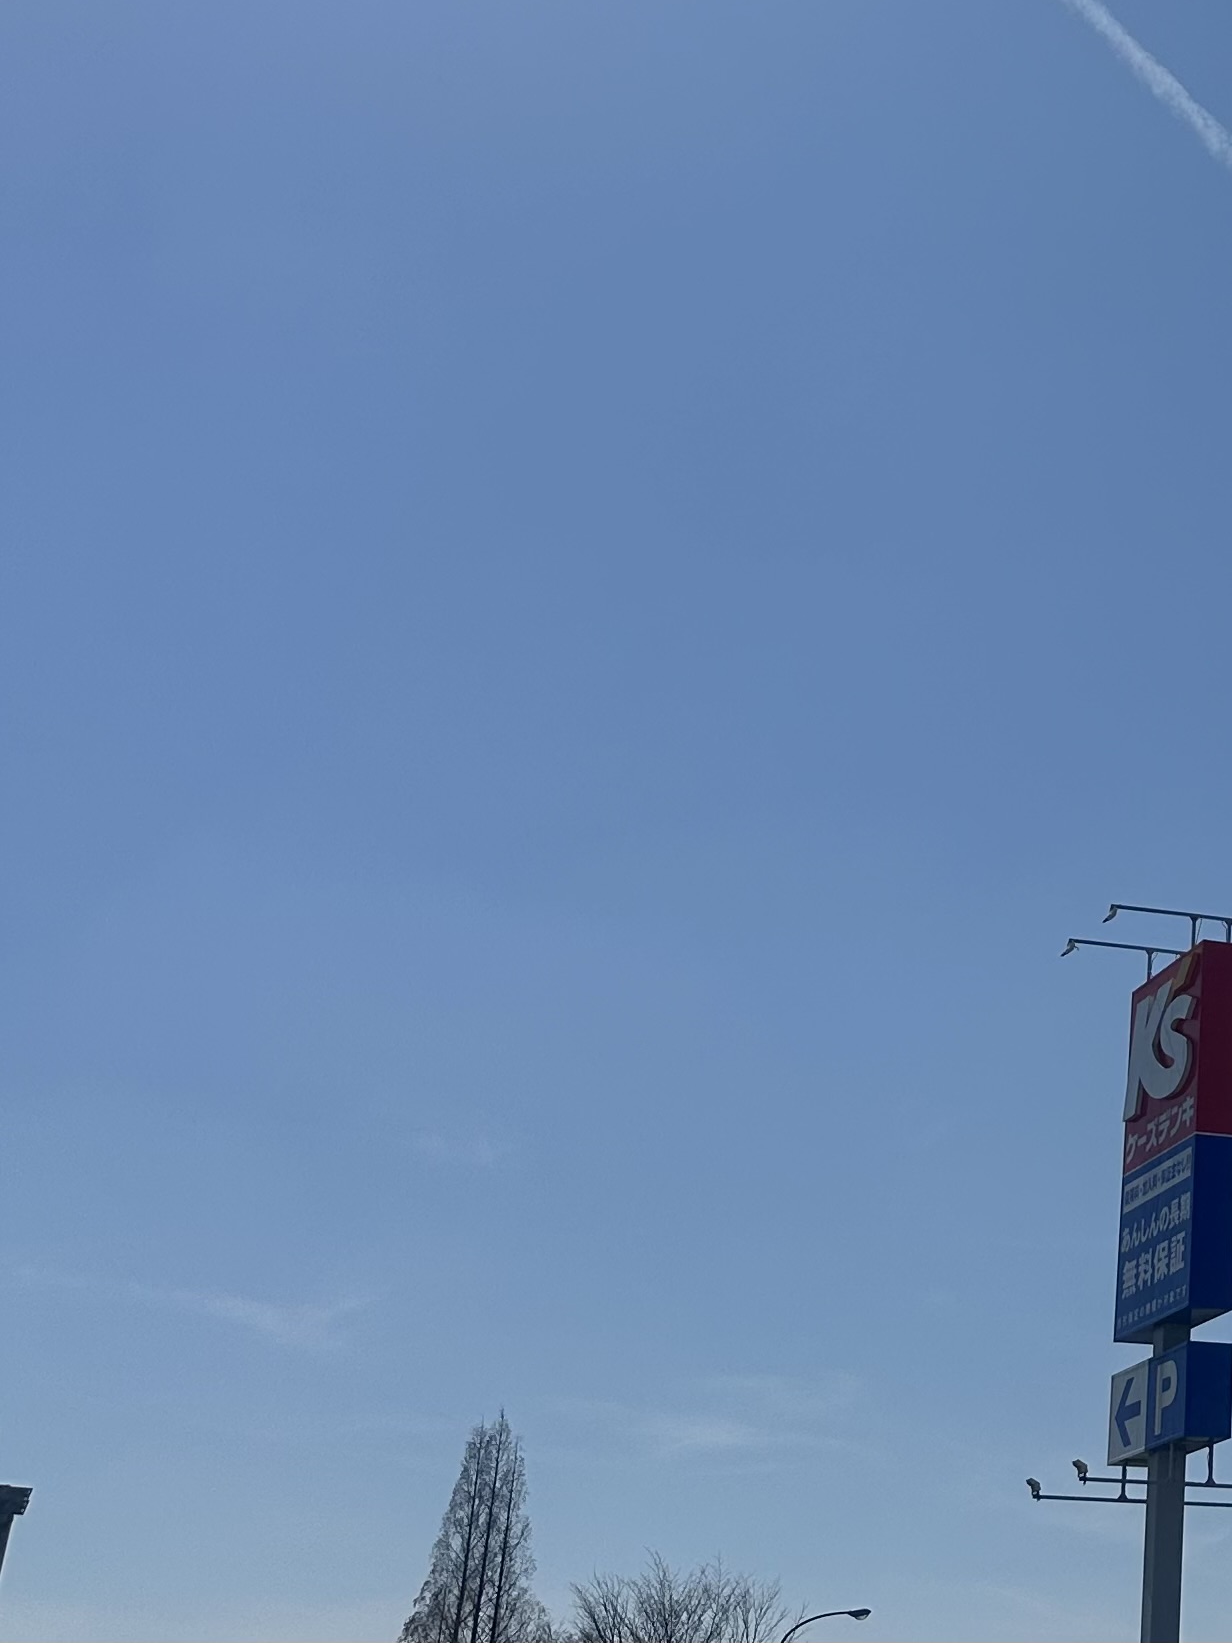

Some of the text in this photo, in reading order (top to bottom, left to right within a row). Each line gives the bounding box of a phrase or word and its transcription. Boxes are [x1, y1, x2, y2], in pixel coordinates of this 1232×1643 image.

[1126, 1096, 1195, 1165] ケーズデンキ
[1122, 1230, 1186, 1299] 無料保証
[1154, 1359, 1178, 1436] P
